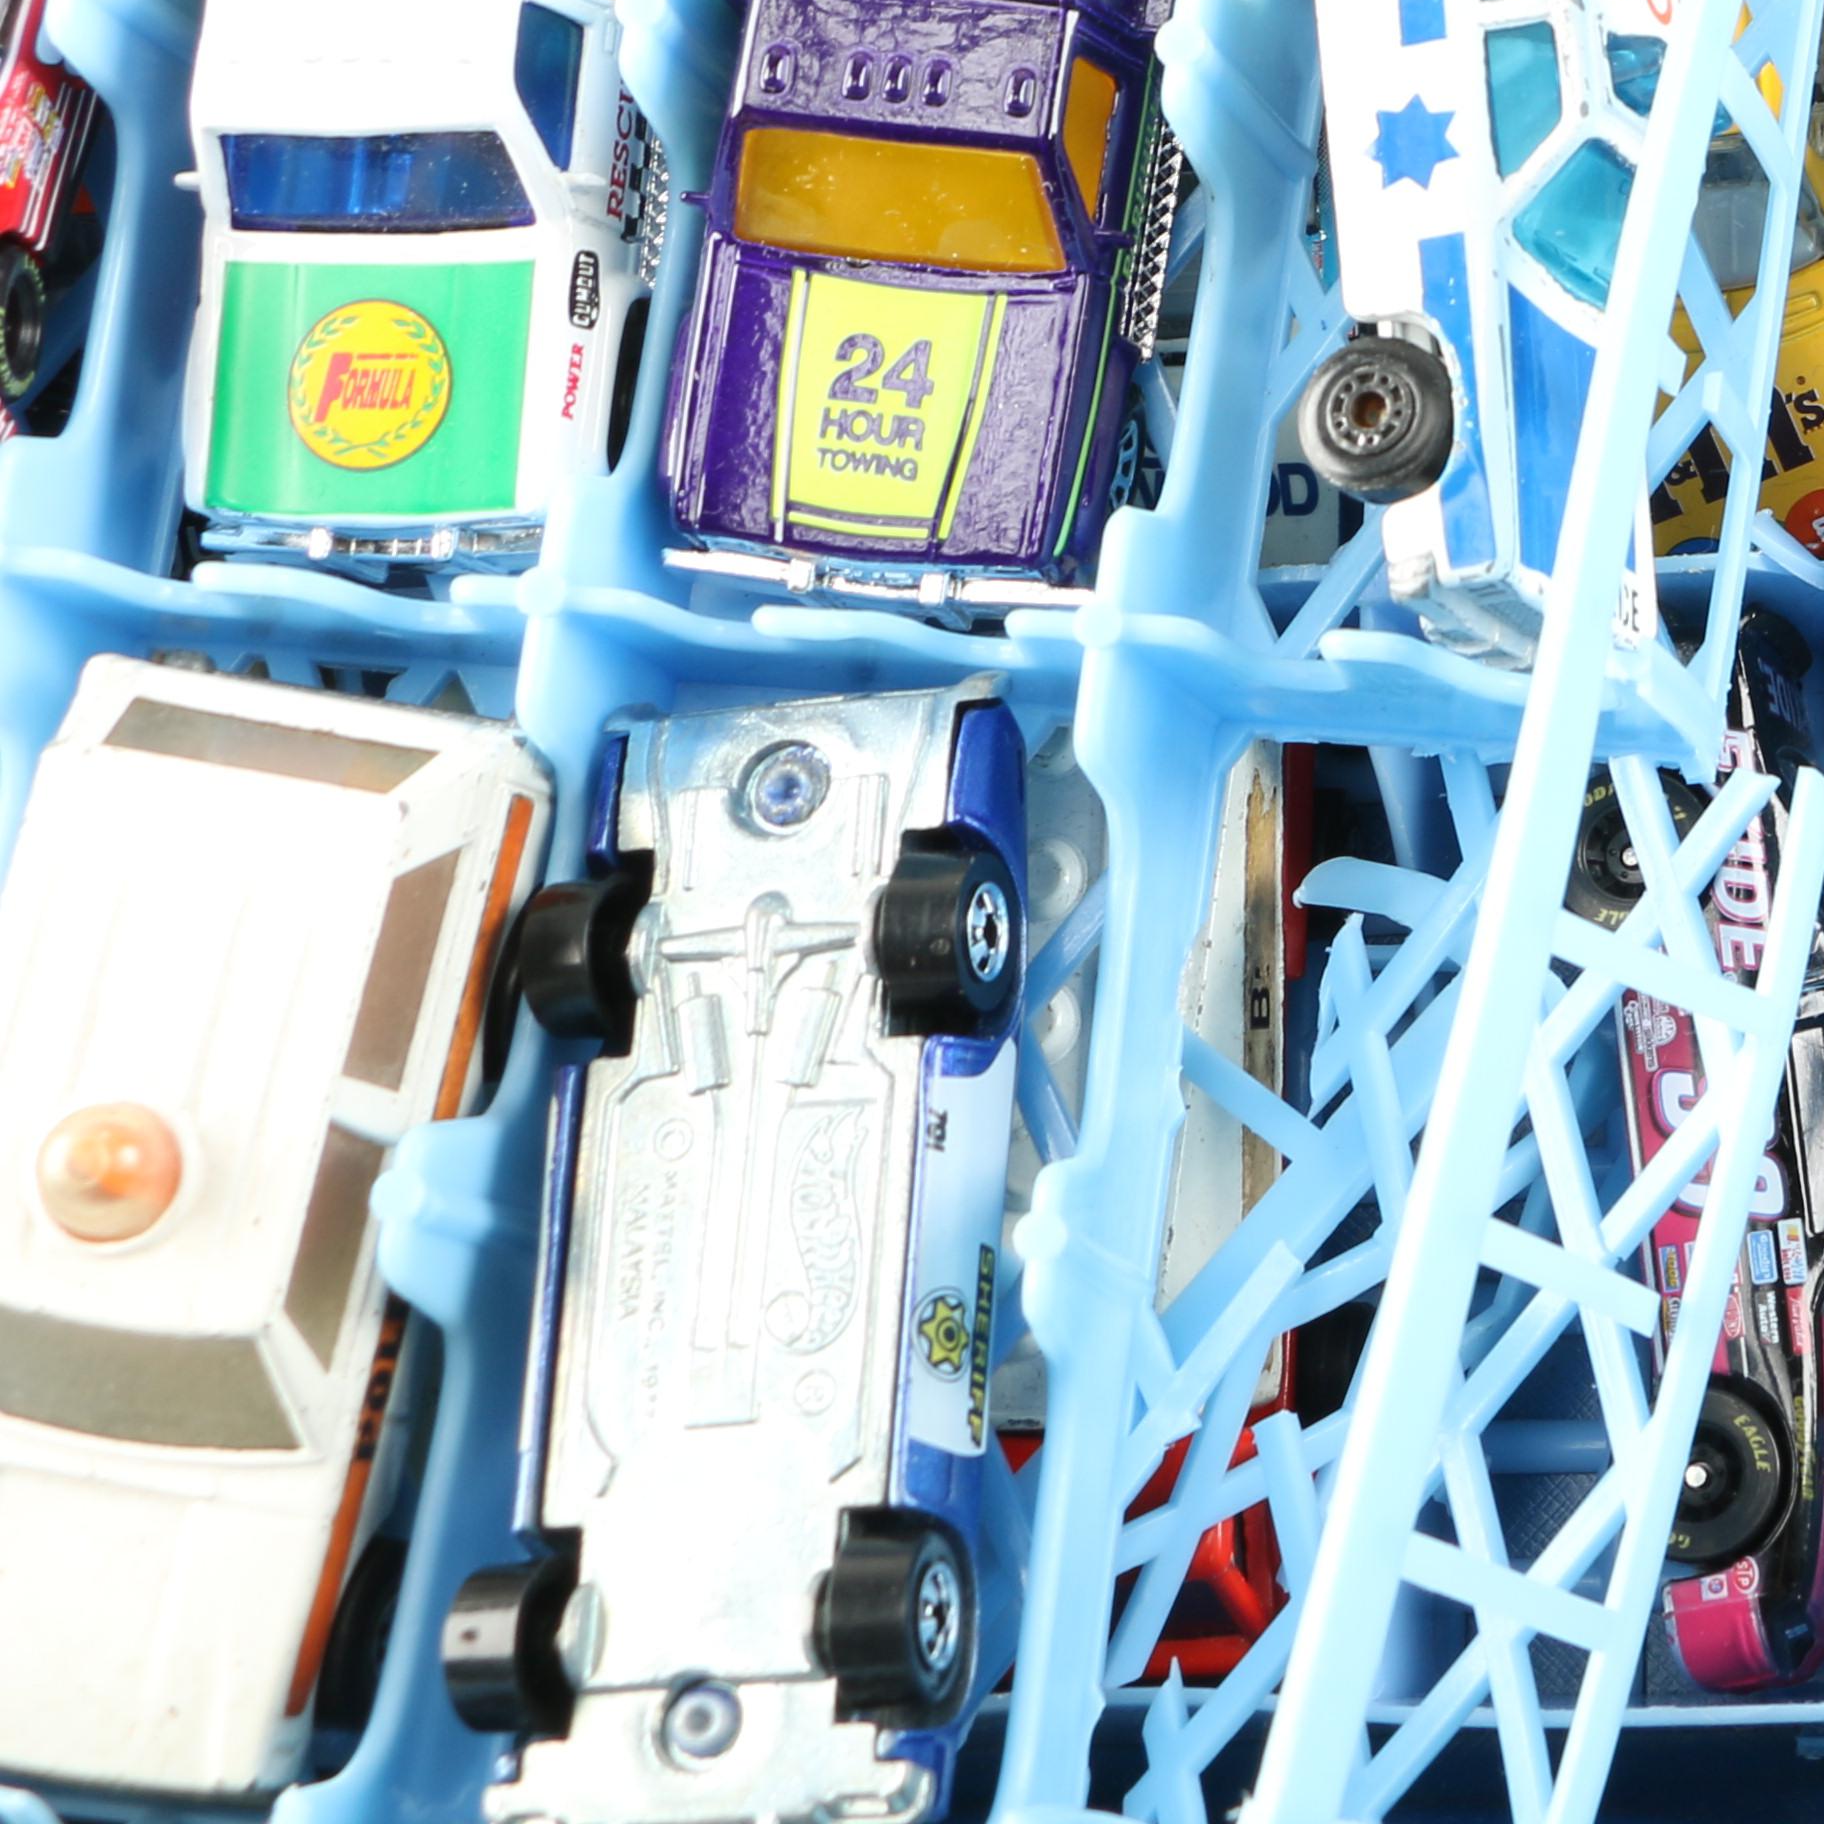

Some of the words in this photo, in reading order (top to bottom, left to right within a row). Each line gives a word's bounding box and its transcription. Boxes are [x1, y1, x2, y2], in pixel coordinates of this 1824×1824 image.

[571, 251, 597, 327] GUMOUT
[562, 344, 584, 420] POWER
[829, 333, 933, 407] 24
[818, 407, 925, 451] HOUR
[816, 448, 919, 481] TOWING
[1758, 1303, 1769, 1333] Auto
[1767, 1291, 1780, 1344] Western
[967, 1244, 995, 1448] SHERIFF
[1733, 1414, 1771, 1473] EAGLE
[1736, 1560, 1755, 1588] STP
